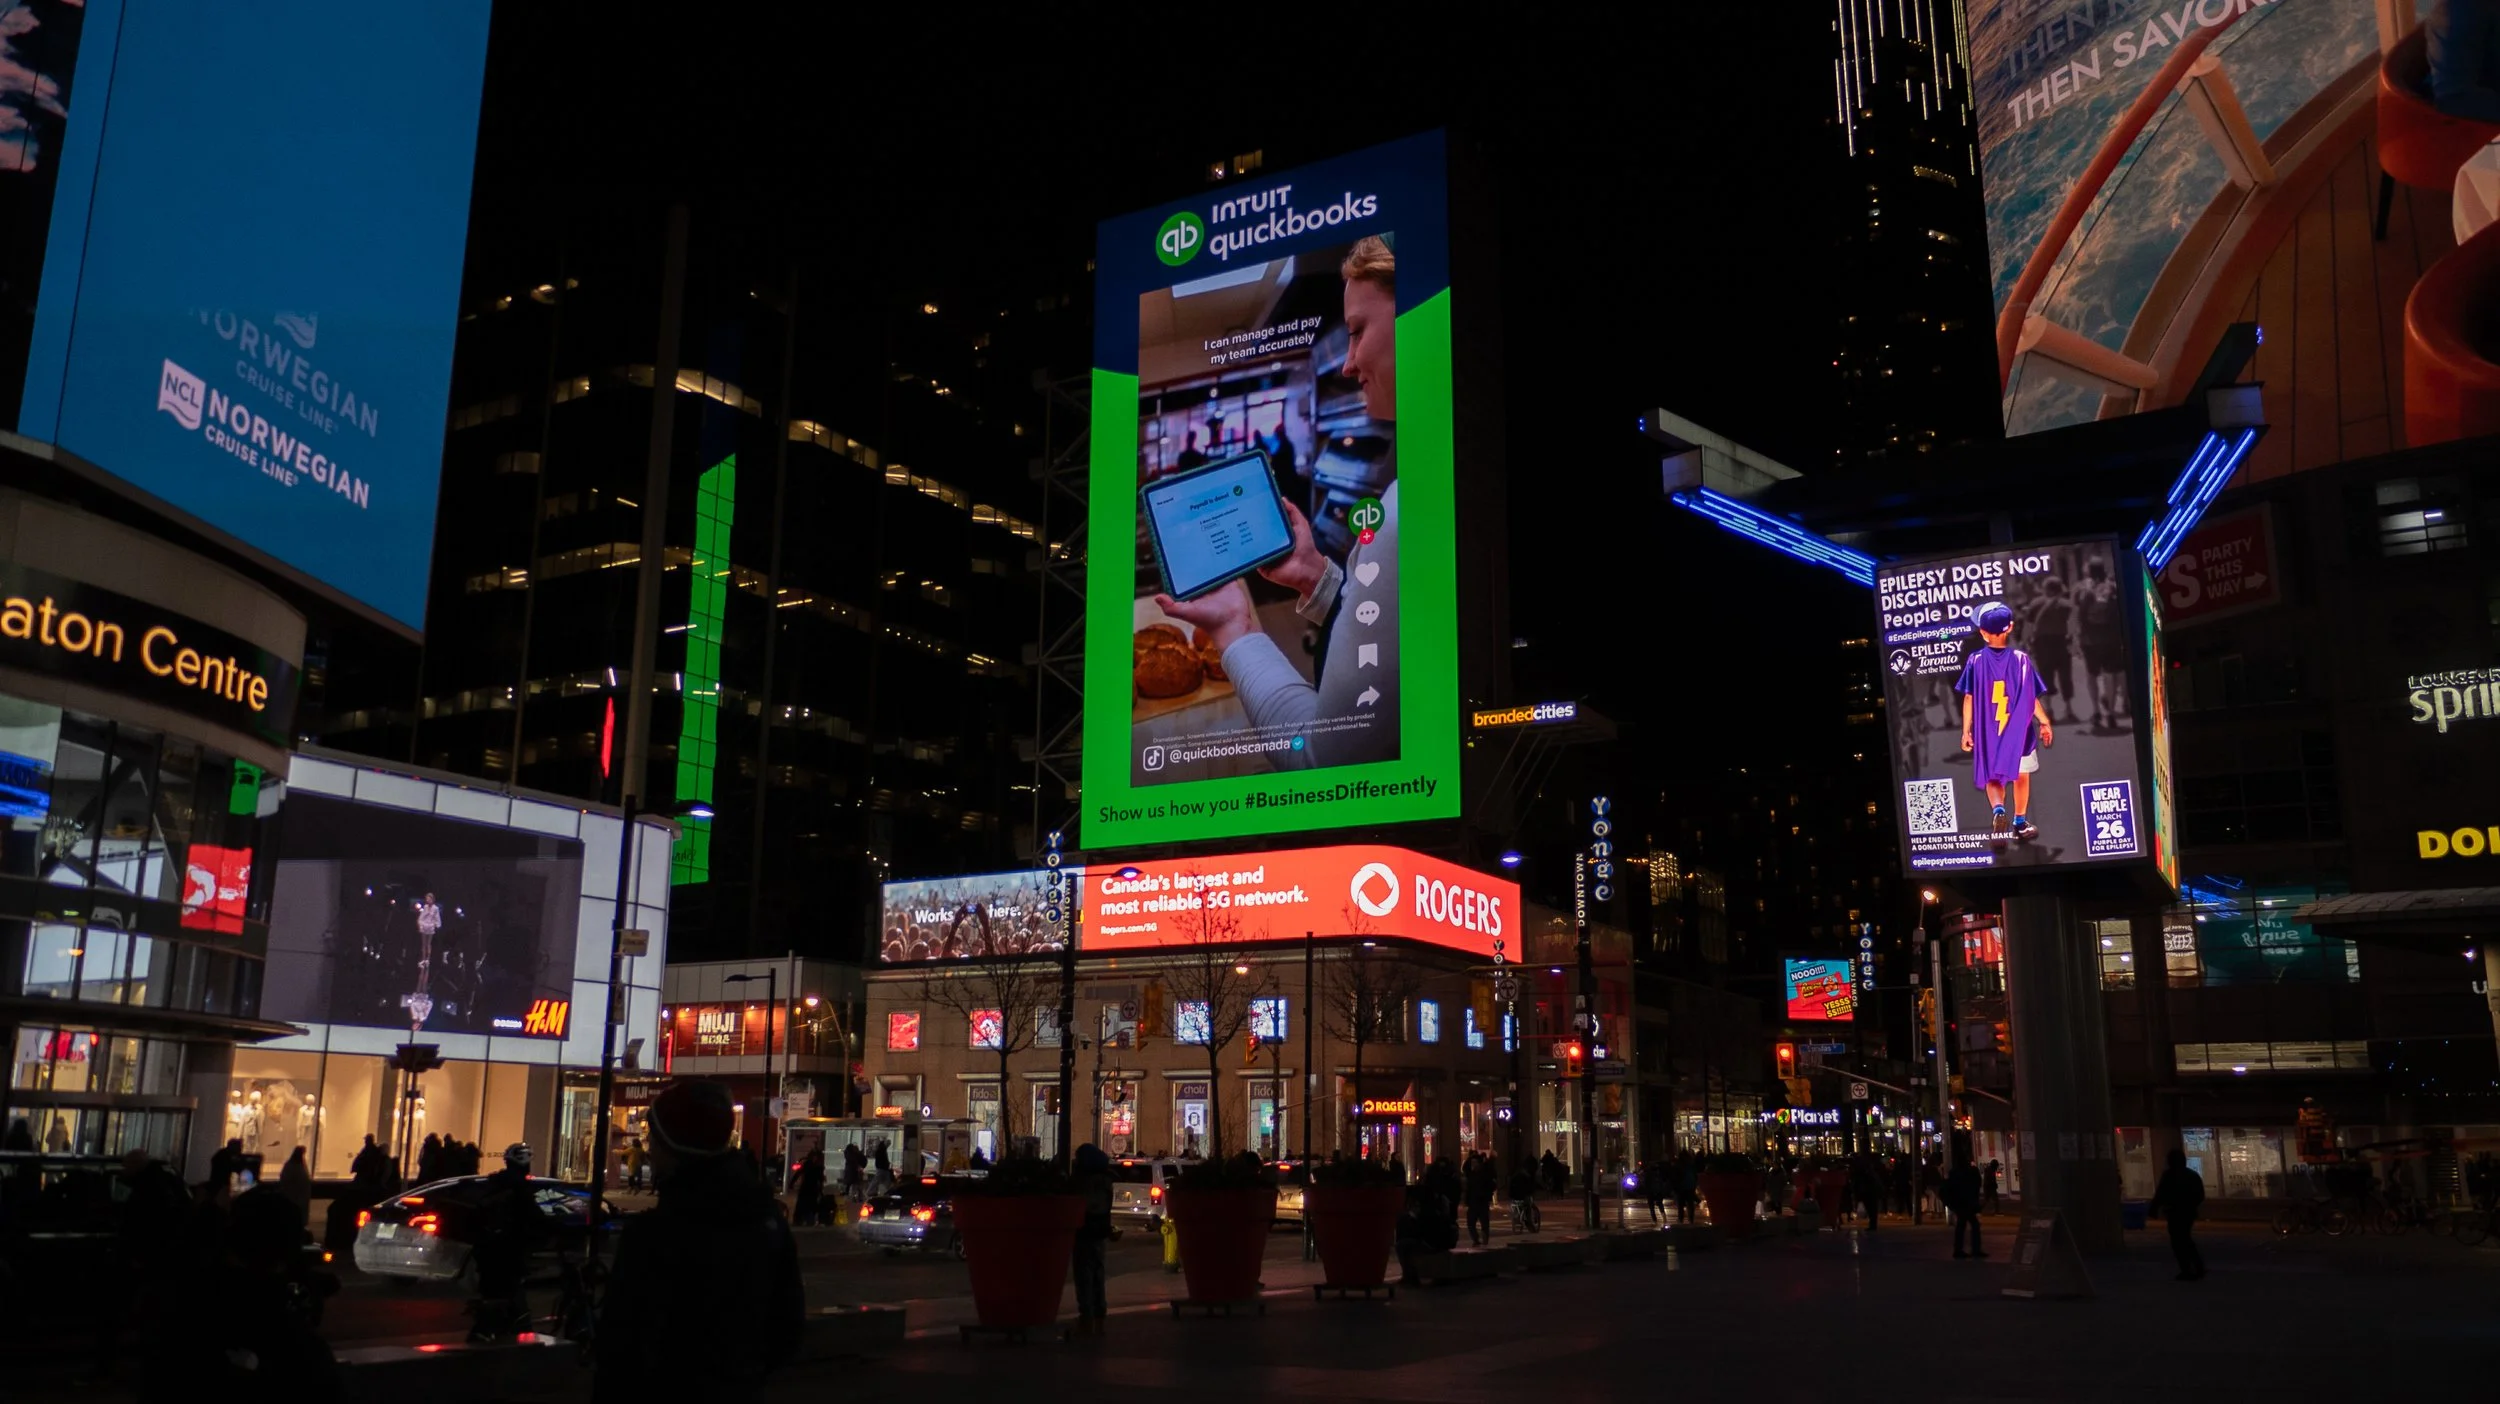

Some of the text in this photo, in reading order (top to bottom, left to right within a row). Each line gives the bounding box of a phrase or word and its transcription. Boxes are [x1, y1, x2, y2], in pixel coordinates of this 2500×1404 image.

[2007, 48, 2101, 129] THEN
[1211, 184, 1293, 225] INTUIT
[1209, 191, 1378, 262] quickbooks
[1204, 315, 1322, 351] I can manage and pay
[1210, 331, 1316, 365] my team accurately
[164, 371, 199, 409] NCL
[236, 359, 296, 411] CRUISE
[204, 423, 259, 468] CRUISE
[207, 387, 370, 510] NORWEGIAN
[2202, 535, 2253, 564] PARTY
[1880, 554, 2051, 594] EPILEPSY DOES NOT
[2204, 558, 2244, 581] THIS
[1881, 579, 2003, 611] DISCRIMINATE
[2206, 576, 2243, 600] WAY
[1883, 607, 1942, 629] People
[1888, 625, 1972, 642] #EndEpilepsyStigma
[0, 596, 269, 712] aton Centre
[1911, 640, 1963, 658] EPILEPSY
[1916, 667, 1928, 675] See
[1939, 664, 1961, 672] Person
[1918, 655, 1958, 668] Toronto
[1353, 712, 1376, 721] product
[1473, 703, 1575, 727] brandedcities
[1331, 723, 1358, 731] additional
[1169, 738, 1291, 763] @quickbookscanada
[1099, 775, 1437, 823] Show us how you #BusinessDifferently
[2091, 786, 2121, 801] WEAR
[2090, 798, 2128, 814] PURPLE
[2095, 813, 2122, 821] MARCH
[1928, 835, 1943, 843] END
[1958, 833, 1990, 842] STIGMA:
[2096, 820, 2126, 839] 26
[1917, 842, 1954, 851] DONATION
[1954, 841, 1983, 849] TODAY.
[2093, 838, 2117, 846] PURPLE
[2105, 842, 2134, 851] EPILEPSY
[1912, 855, 1993, 868] epilepsytoronto.org
[1101, 865, 1264, 896] Canada's largest and
[1575, 852, 1585, 927] DOWNTOWN
[1063, 877, 1072, 945] DOWNTOWN
[1100, 885, 1309, 916] most reliable 5G network.
[1415, 874, 1501, 937] ROGERS
[915, 909, 954, 924] Works
[1100, 922, 1158, 937] Rogers.com/5G
[1848, 958, 1858, 1007] DOWNTOWN
[1823, 997, 1851, 1010] YESSS
[524, 1000, 569, 1036] H&M
[698, 1012, 736, 1034] MUJI
[625, 1086, 648, 1099] MUJI
[972, 1088, 989, 1099] fido
[1375, 1101, 1416, 1113] ROGERS
[1790, 1108, 1839, 1123] Planet
